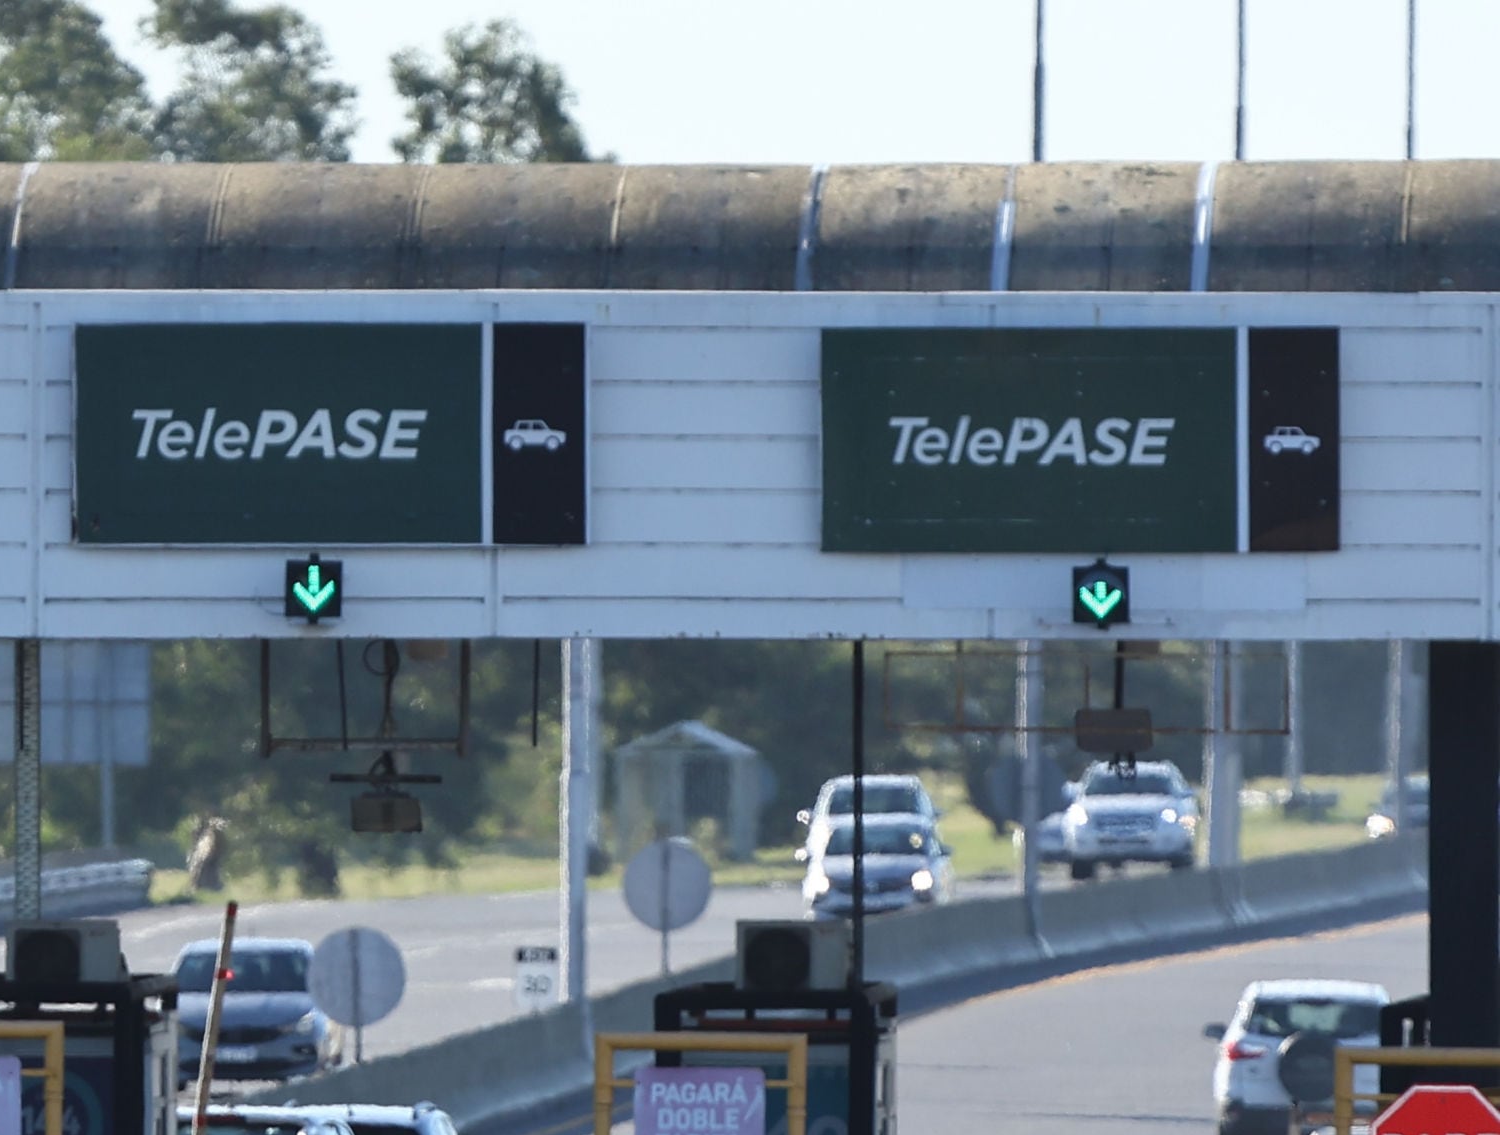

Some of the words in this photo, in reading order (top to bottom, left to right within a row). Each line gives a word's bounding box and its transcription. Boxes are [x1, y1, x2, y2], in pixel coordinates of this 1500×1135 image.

[131, 408, 428, 460] TelePASE
[888, 415, 1176, 466] TelePASE
[651, 1077, 748, 1104] PAGARÁ
[657, 1107, 740, 1130] DOBLE
